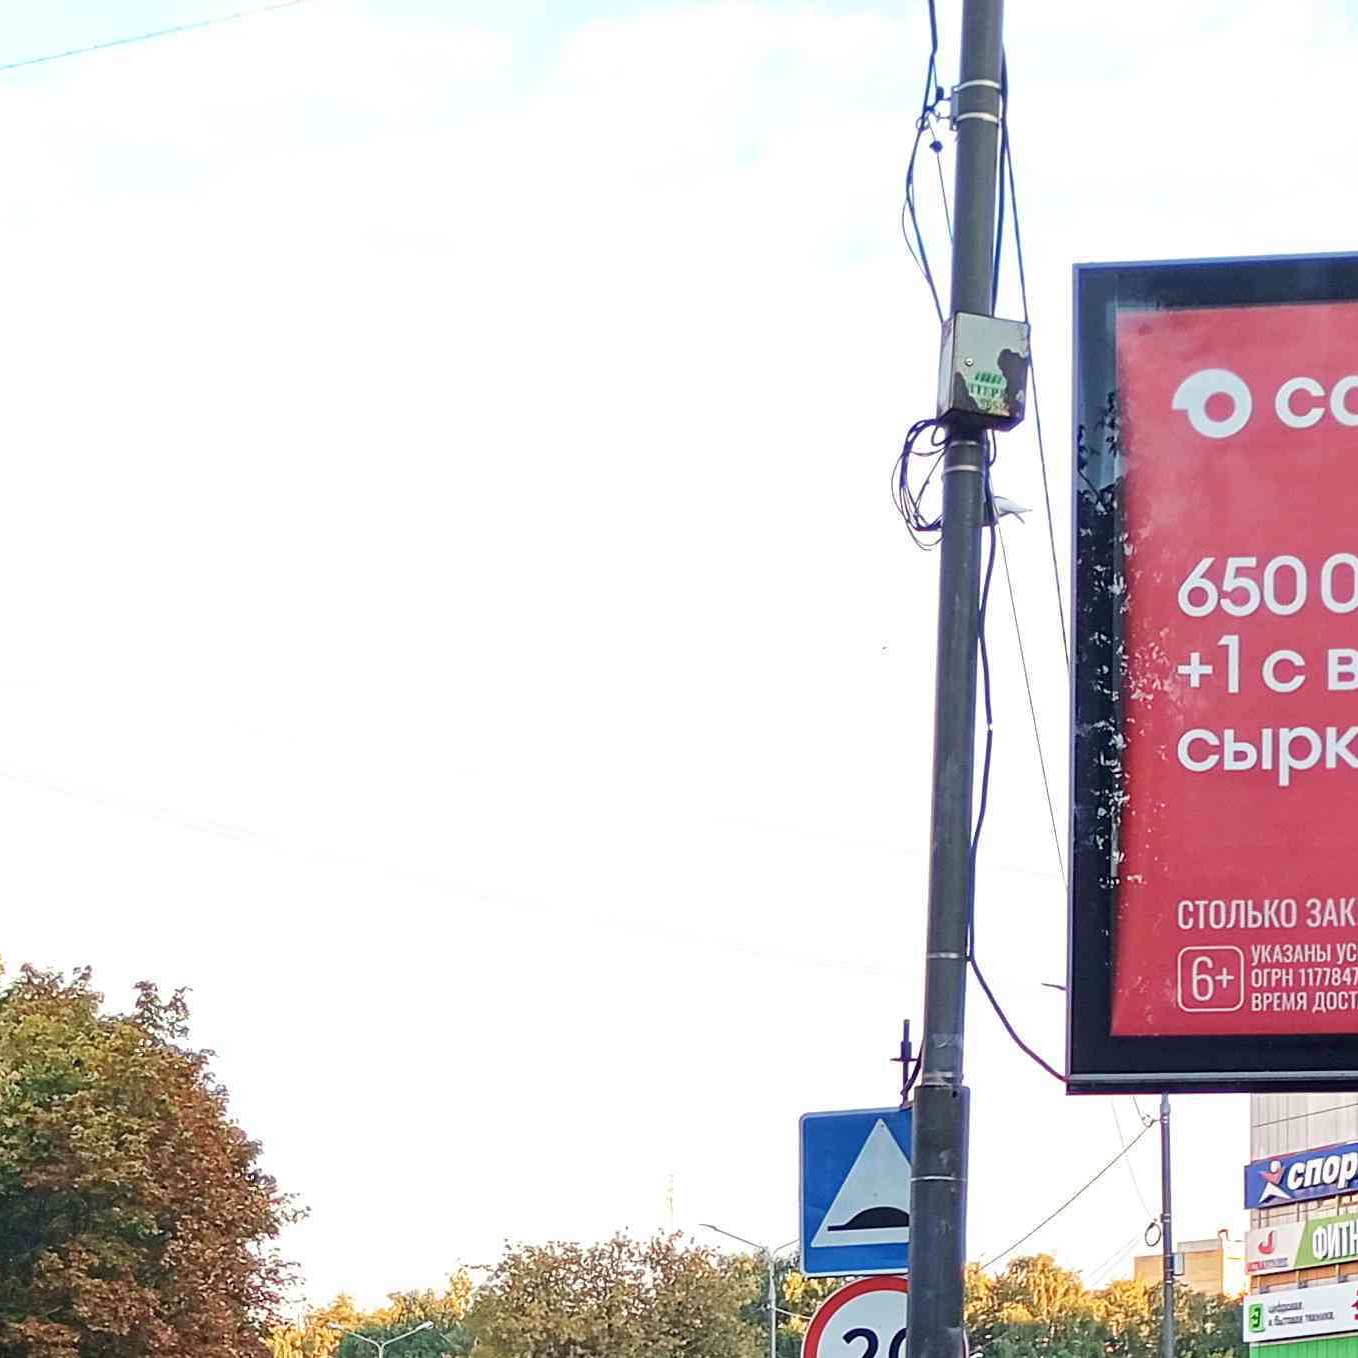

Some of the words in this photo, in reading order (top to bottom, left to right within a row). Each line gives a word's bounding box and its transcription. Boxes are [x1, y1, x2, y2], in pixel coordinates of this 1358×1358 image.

[1176, 633, 1241, 694] +1
[1261, 649, 1307, 693] с
[1177, 898, 1297, 930] СТОЛЬКО
[1251, 943, 1331, 966] УКАЗАНЫ
[1191, 956, 1235, 1002] 6+
[1251, 968, 1293, 988] ОГРН
[1251, 992, 1307, 1012] ВРЕМЯ
